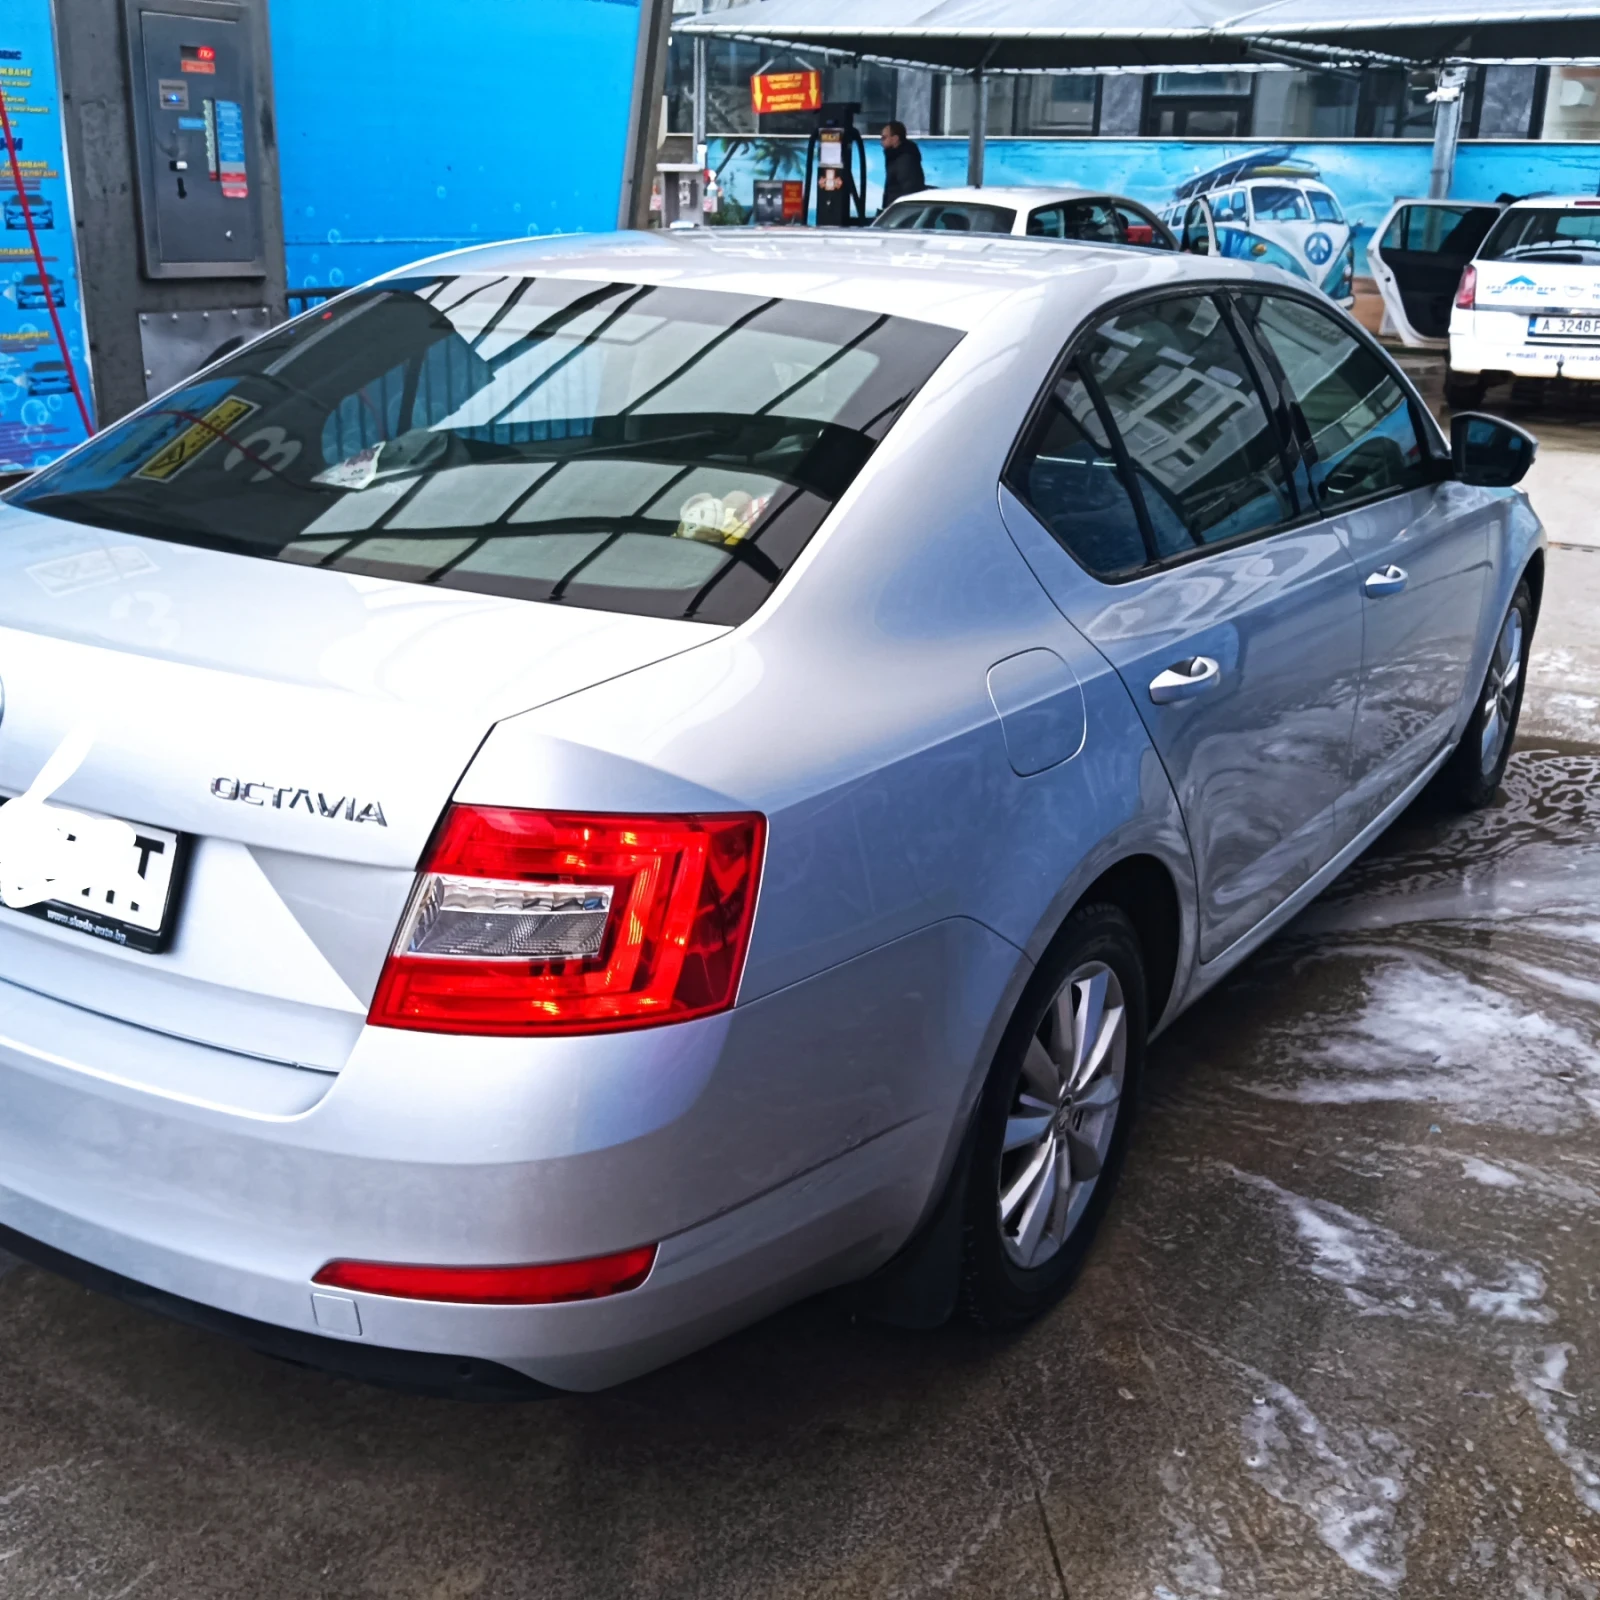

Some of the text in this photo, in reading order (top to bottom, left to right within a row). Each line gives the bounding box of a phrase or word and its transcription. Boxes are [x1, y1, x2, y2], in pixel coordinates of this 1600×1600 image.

[1542, 319, 1550, 332] A
[1558, 319, 1591, 333] 3248
[210, 776, 388, 828] OCTAVIA
